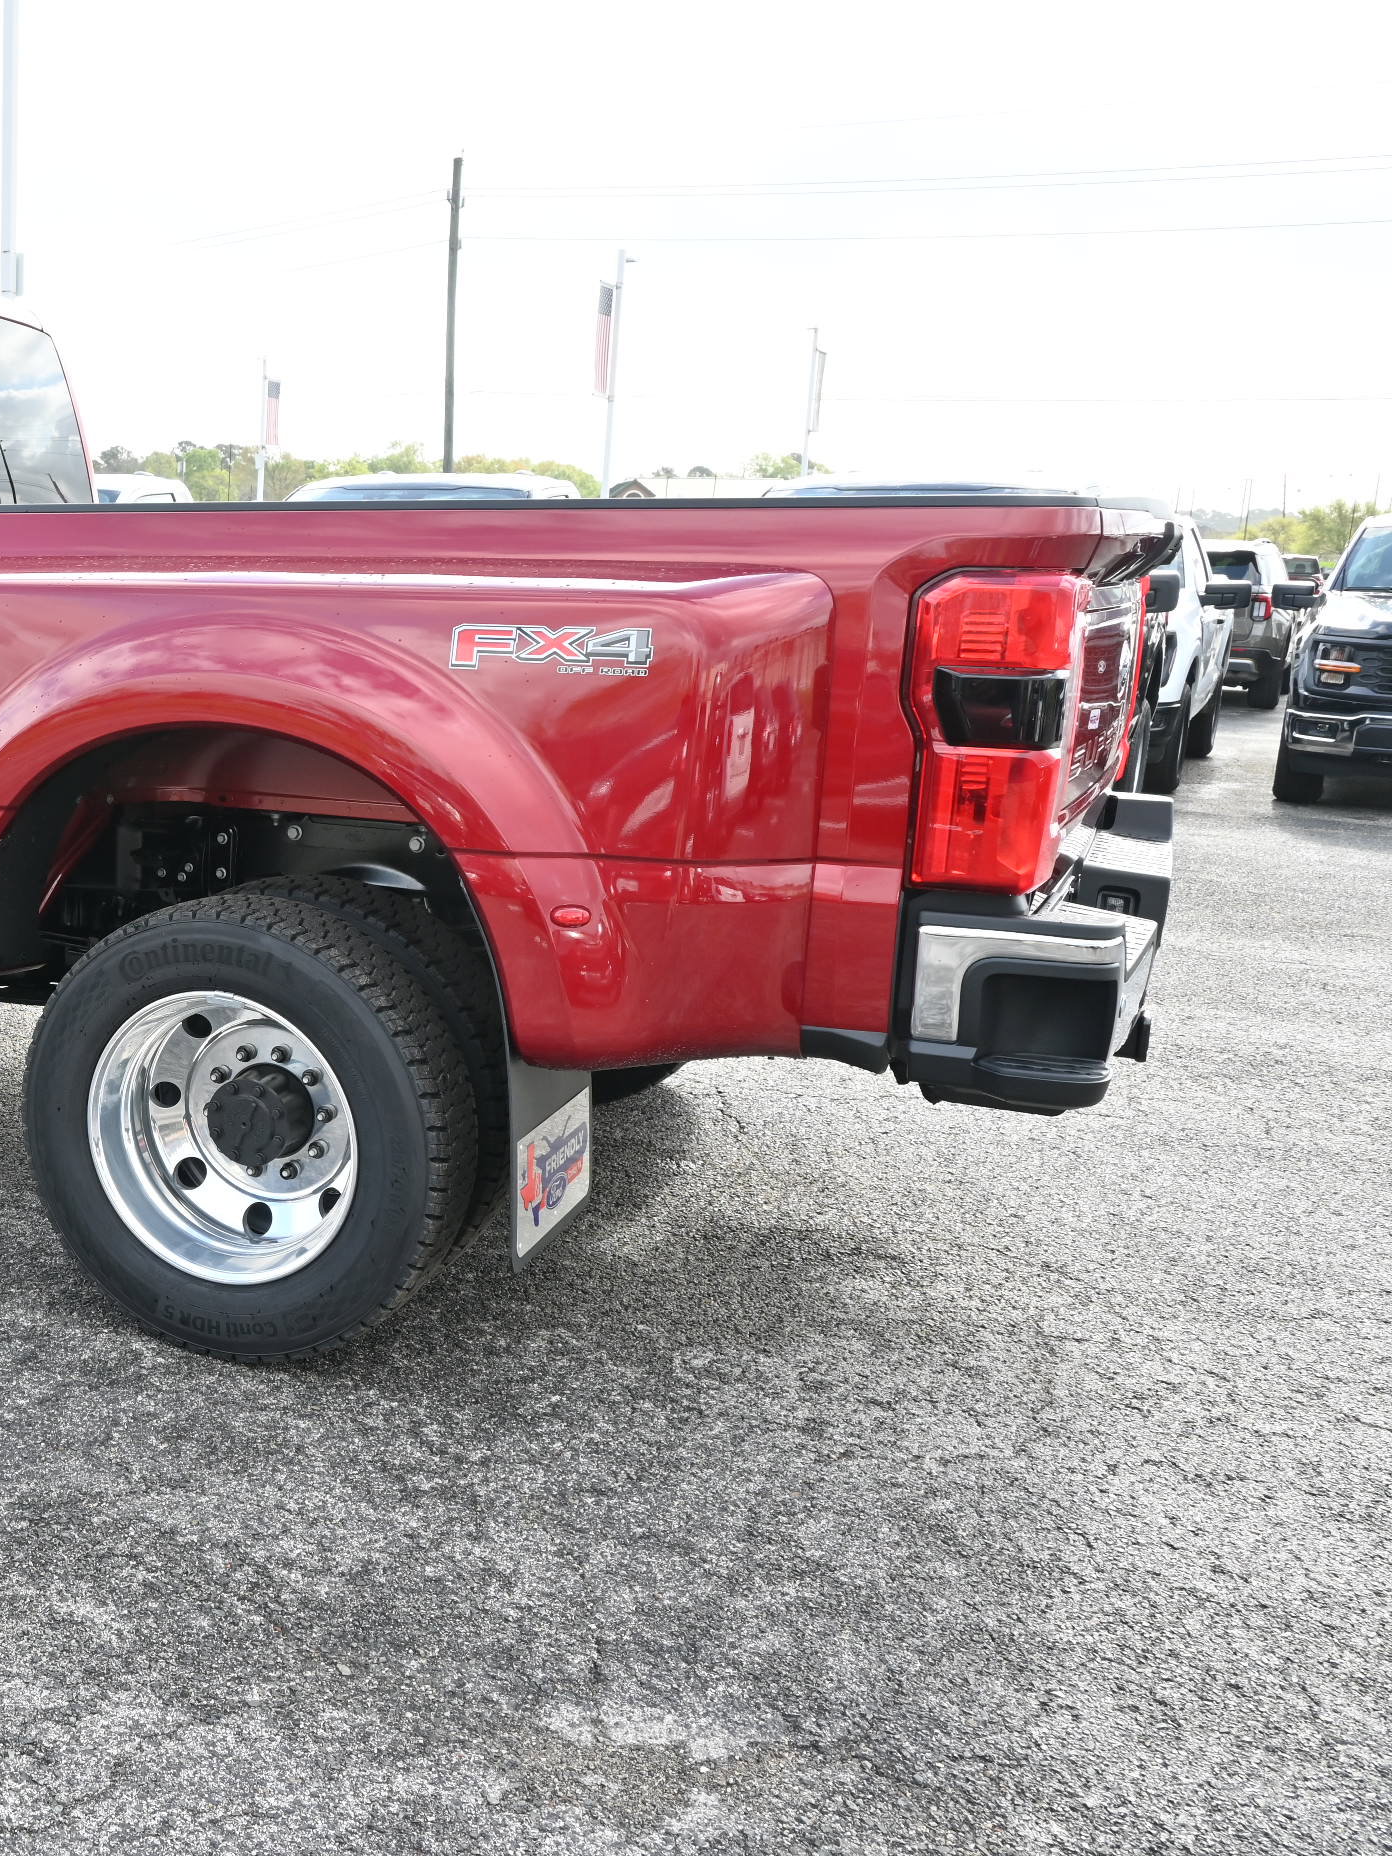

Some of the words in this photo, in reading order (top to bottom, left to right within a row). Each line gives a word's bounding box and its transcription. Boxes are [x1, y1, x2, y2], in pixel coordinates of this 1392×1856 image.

[449, 623, 654, 669] FX4
[557, 665, 594, 675] OFF
[599, 667, 649, 677] ROAD
[118, 937, 275, 983] Continental
[545, 1130, 584, 1177] FRIENDLY
[178, 1308, 221, 1337] HDR
[224, 1319, 279, 1338] Conti
